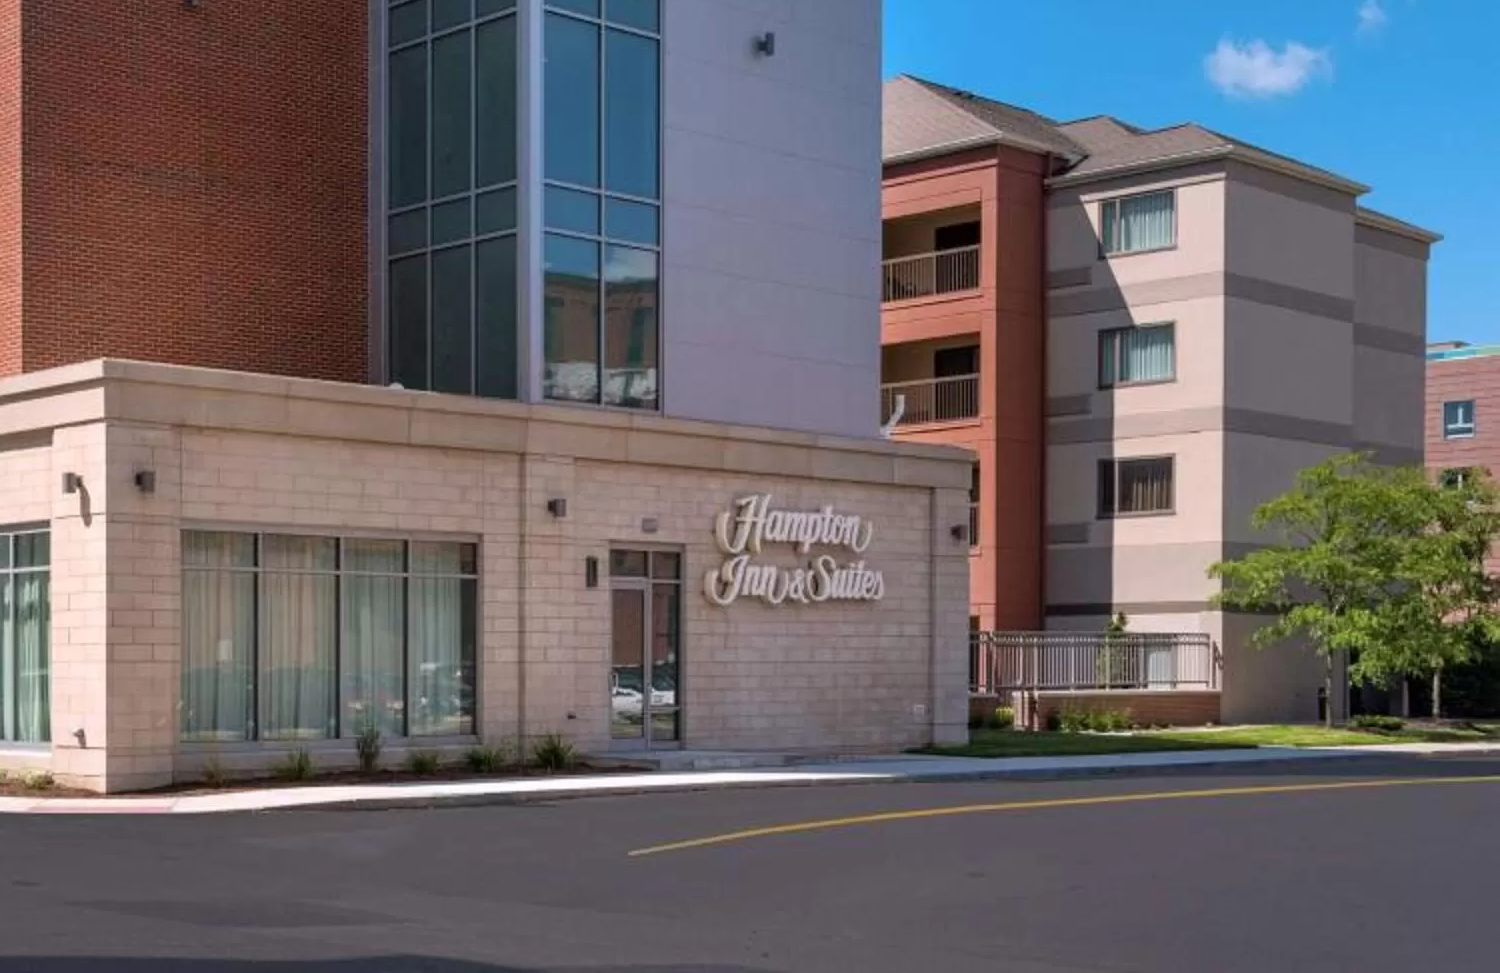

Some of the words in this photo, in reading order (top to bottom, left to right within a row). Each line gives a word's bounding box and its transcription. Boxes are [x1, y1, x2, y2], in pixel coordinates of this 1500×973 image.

[715, 494, 872, 553] Hampton
[704, 555, 788, 604] Inn
[789, 568, 810, 603] &
[807, 555, 884, 601] Suites
